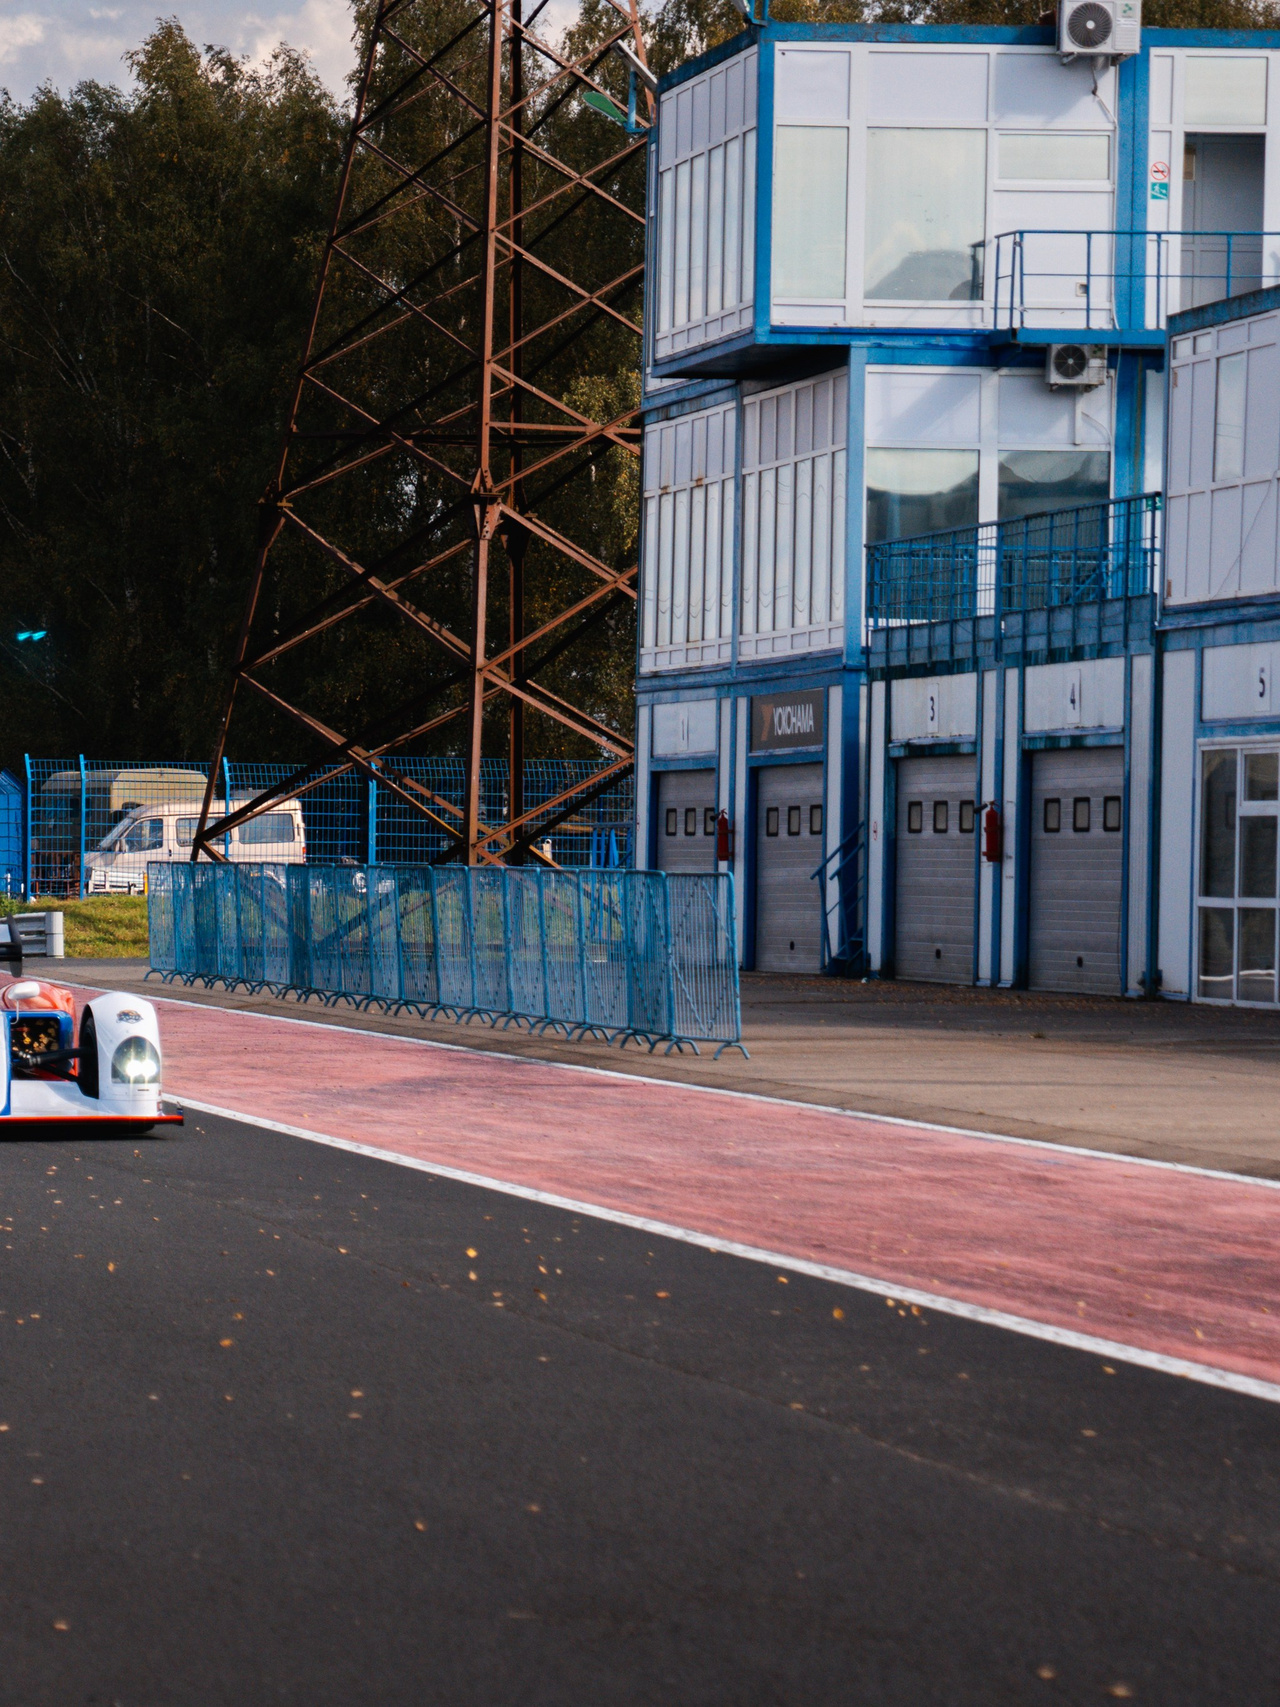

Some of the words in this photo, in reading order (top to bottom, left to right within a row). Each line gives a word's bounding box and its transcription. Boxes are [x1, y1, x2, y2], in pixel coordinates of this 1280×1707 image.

[1070, 682, 1076, 711] 4
[1259, 666, 1266, 698] 5
[773, 703, 814, 736] YOKOHAMA
[930, 695, 935, 721] 3
